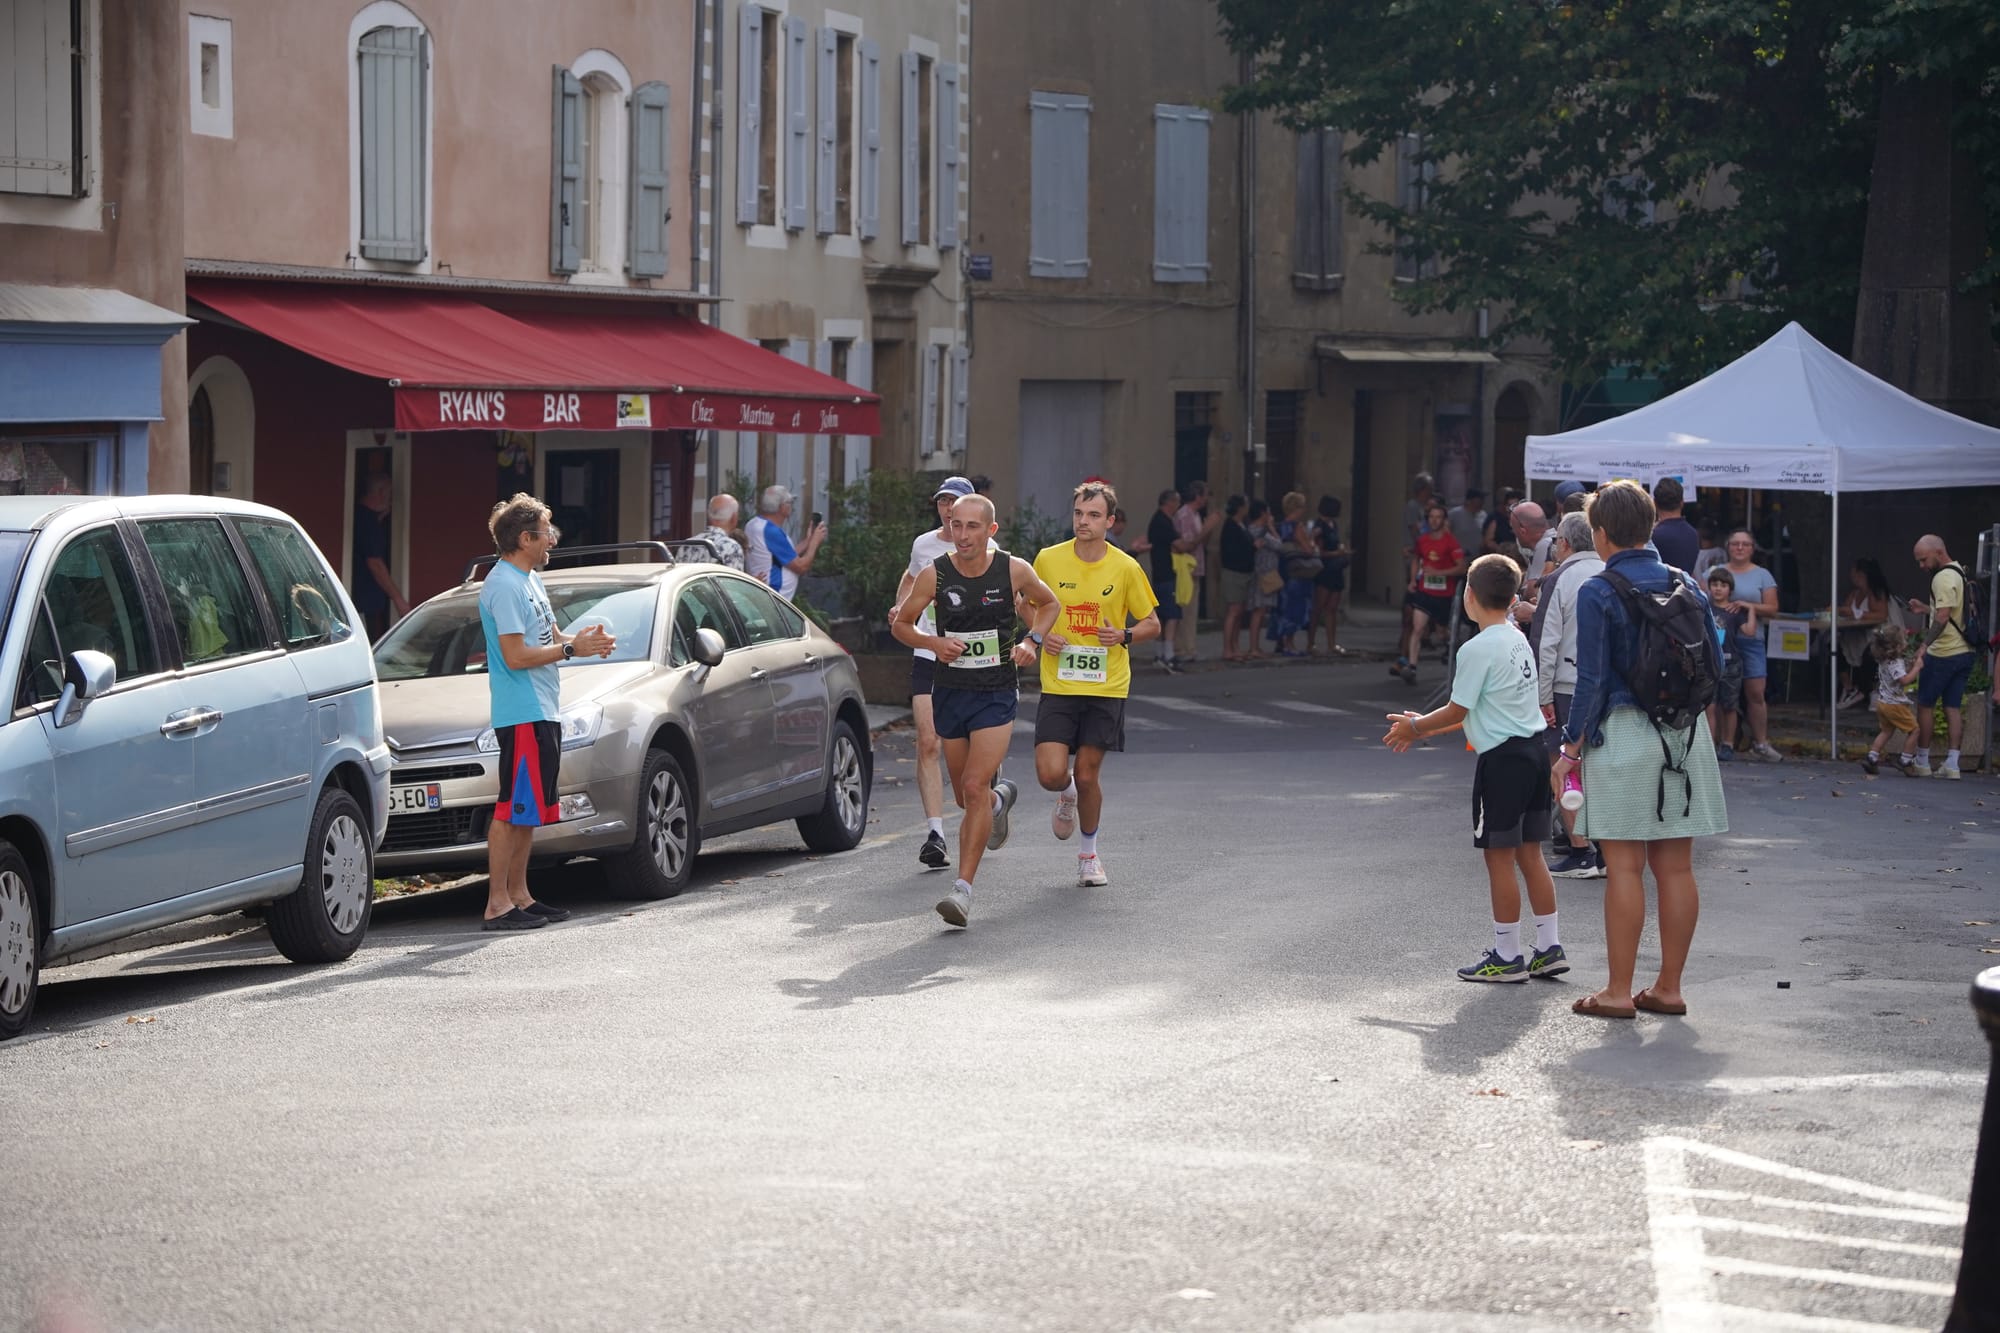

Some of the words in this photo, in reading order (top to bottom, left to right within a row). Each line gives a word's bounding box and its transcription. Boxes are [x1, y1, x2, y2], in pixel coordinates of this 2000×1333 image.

[439, 391, 505, 422] RYAN'S
[543, 393, 580, 422] BAR
[691, 398, 715, 423] Chez
[739, 404, 775, 426] Martine
[792, 411, 800, 427] et
[819, 406, 839, 432] John
[961, 641, 985, 657] 20
[1066, 654, 1100, 670] 158
[429, 797, 439, 807] 48
